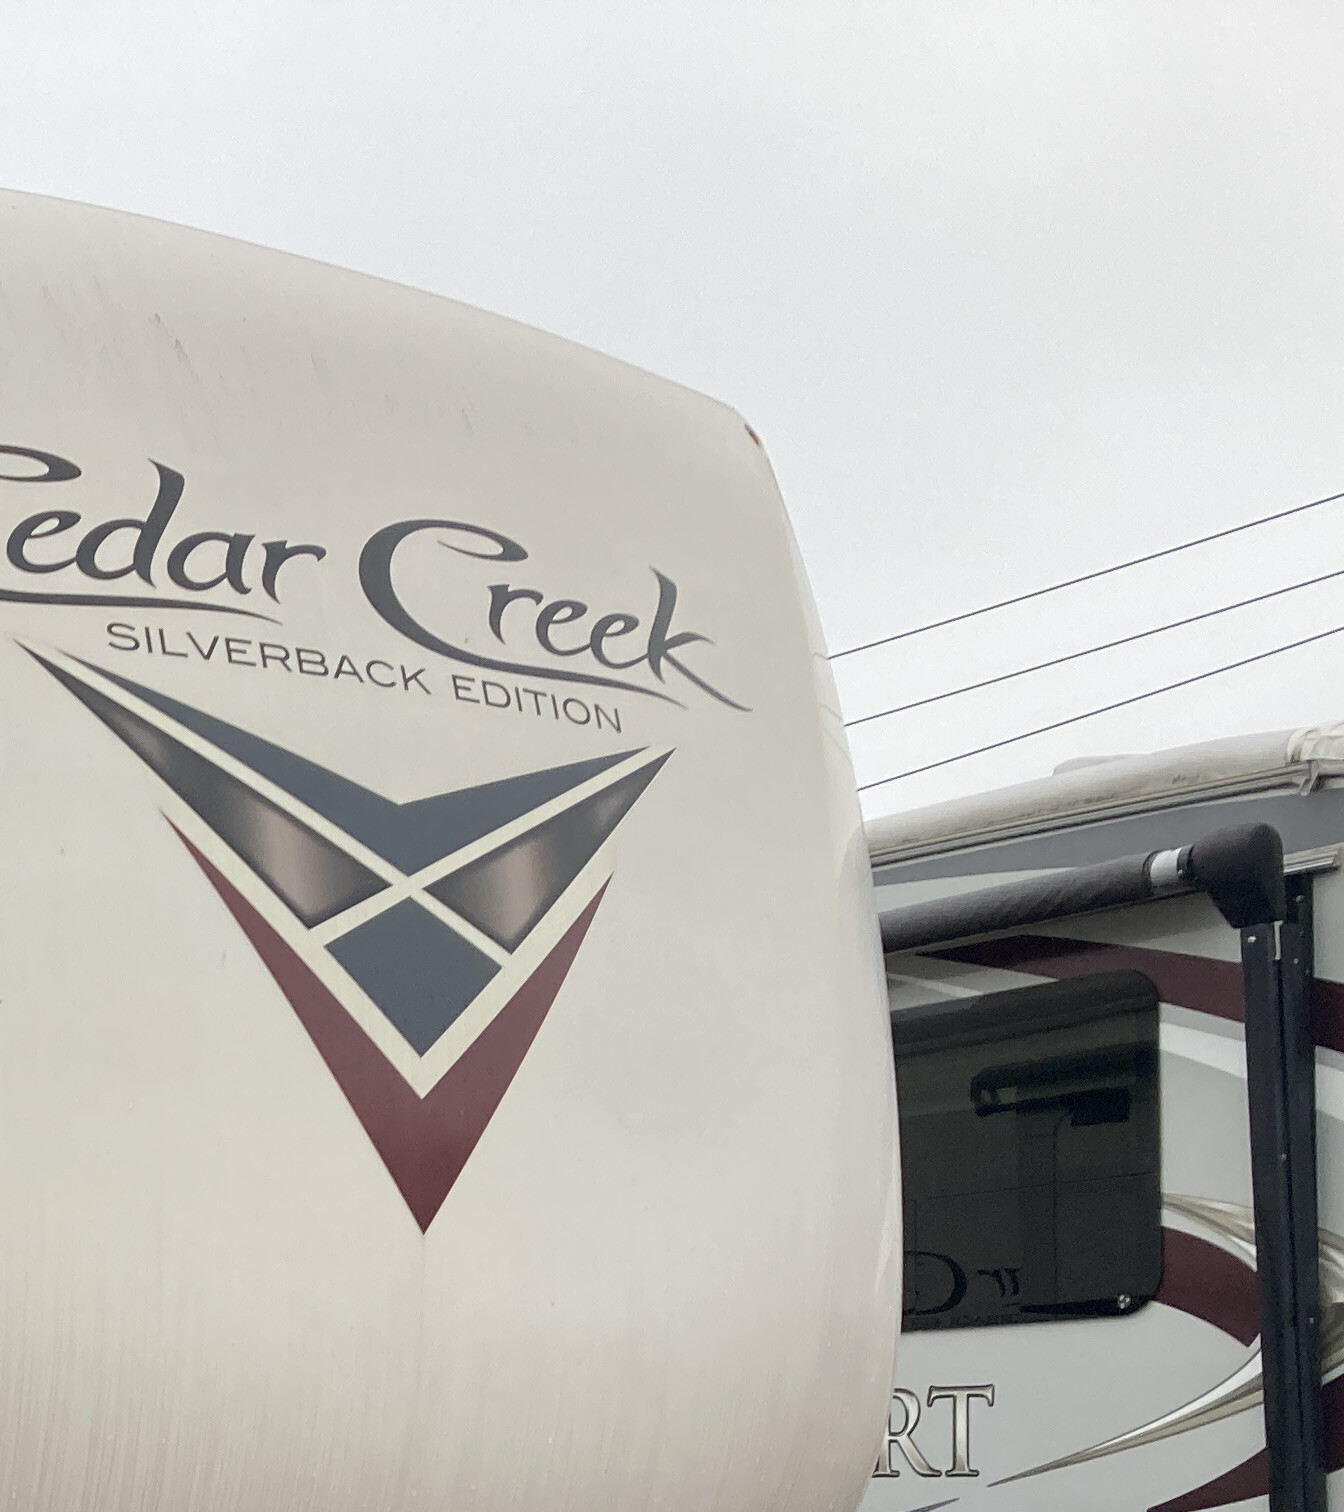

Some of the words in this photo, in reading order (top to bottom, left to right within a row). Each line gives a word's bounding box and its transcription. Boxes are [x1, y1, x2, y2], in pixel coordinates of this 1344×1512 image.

[106, 621, 433, 696] SILVERBACK
[451, 674, 622, 734] EDITION
[358, 518, 754, 712] Creek
